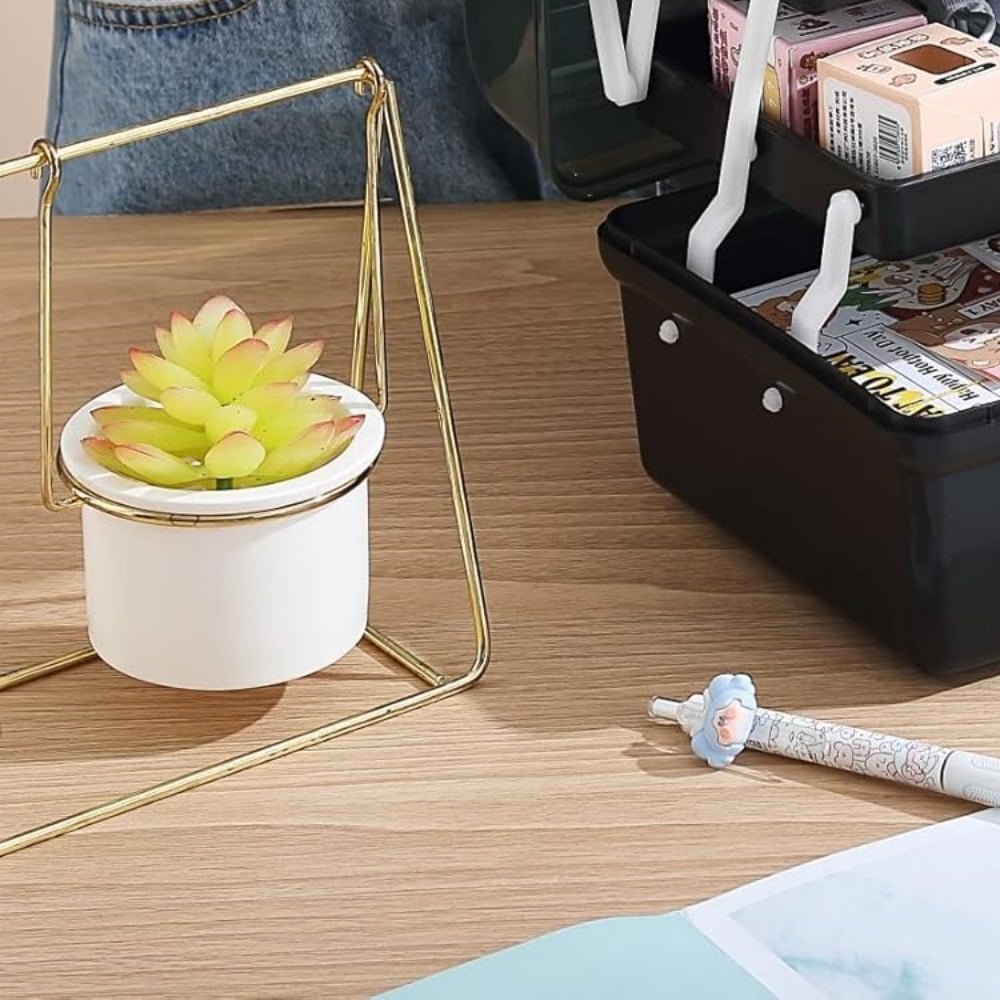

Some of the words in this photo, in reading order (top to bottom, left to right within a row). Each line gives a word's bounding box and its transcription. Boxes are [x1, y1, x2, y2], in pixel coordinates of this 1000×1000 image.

[963, 308, 979, 316] 1
[863, 329, 895, 350] Day
[891, 343, 938, 377] Hotpot
[861, 376, 907, 401] TO
[932, 373, 980, 402] Happy
